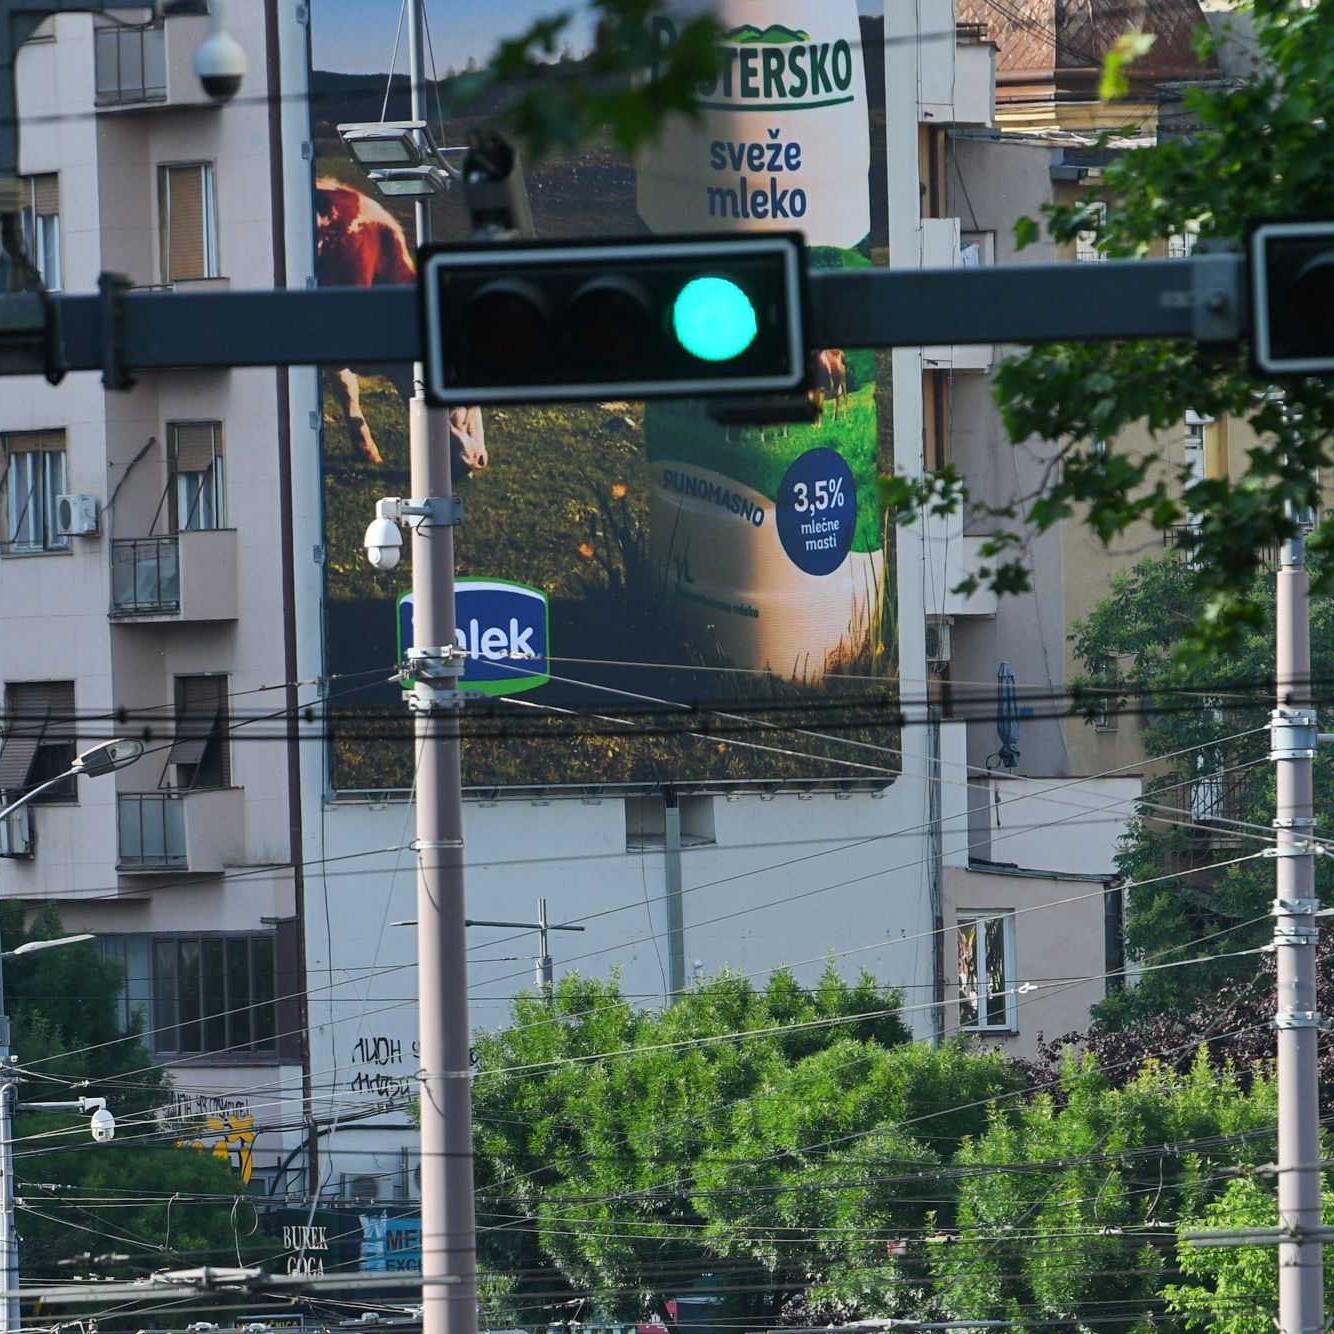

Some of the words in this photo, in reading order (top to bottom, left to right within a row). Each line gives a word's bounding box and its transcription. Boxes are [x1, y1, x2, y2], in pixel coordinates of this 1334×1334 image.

[710, 128, 802, 172] sveže
[707, 177, 807, 219] mleko
[662, 468, 765, 527] PUNOMASNO
[793, 477, 845, 516] 3,5%
[801, 517, 840, 535] mlečne
[805, 534, 837, 551] masti
[283, 1226, 329, 1250] BUREK
